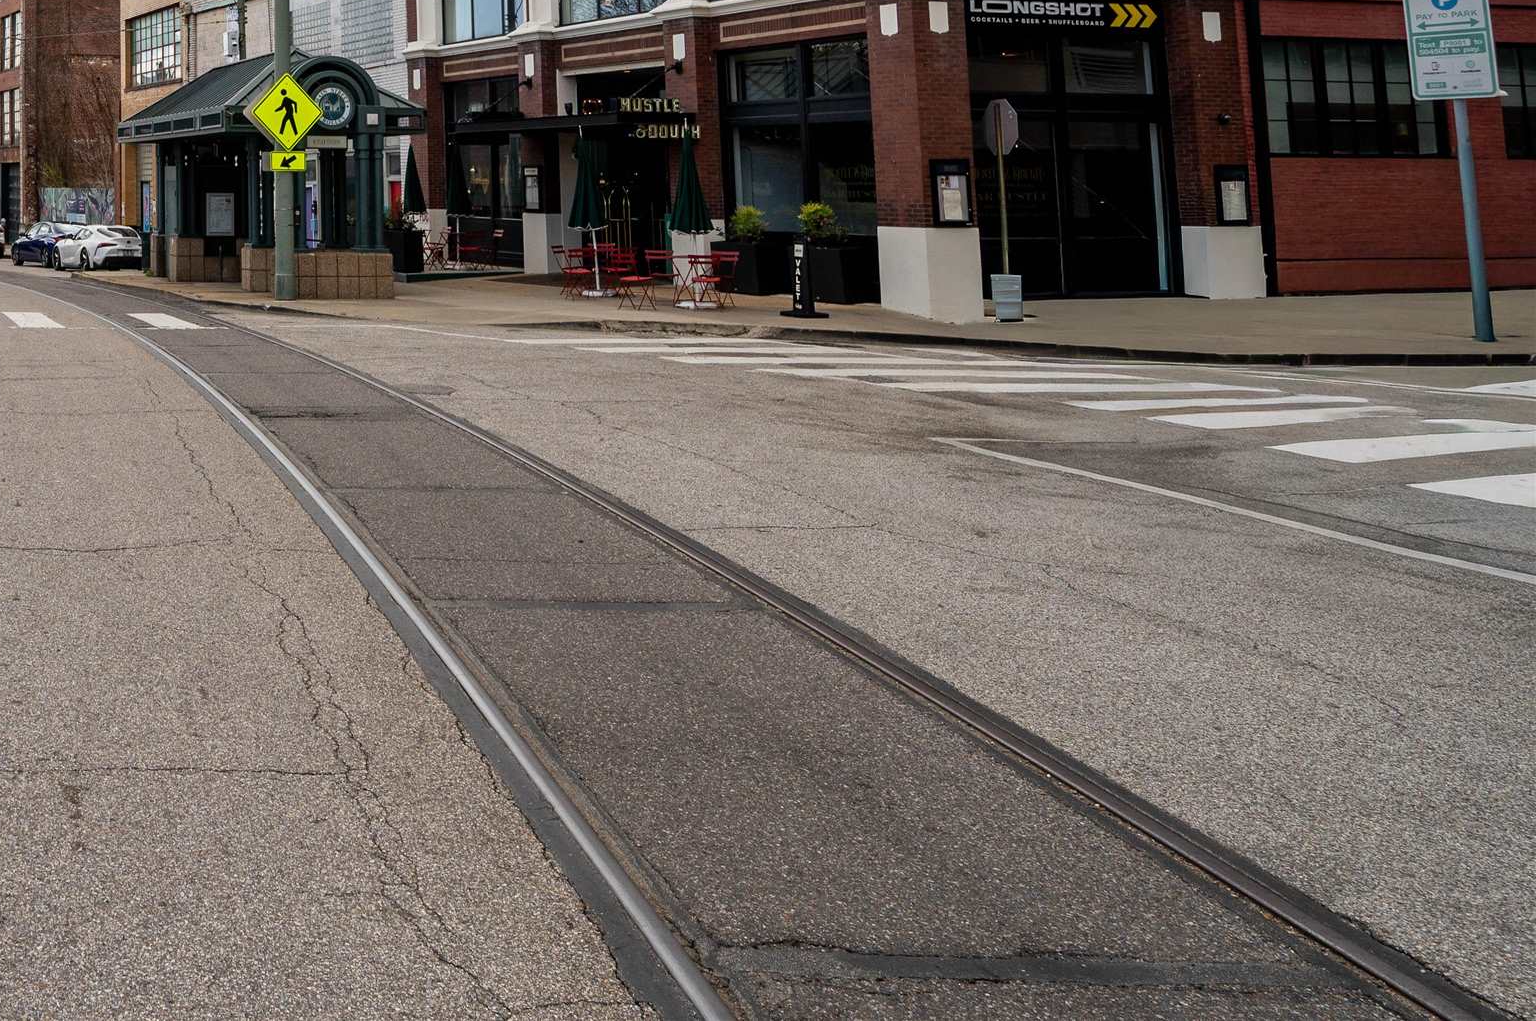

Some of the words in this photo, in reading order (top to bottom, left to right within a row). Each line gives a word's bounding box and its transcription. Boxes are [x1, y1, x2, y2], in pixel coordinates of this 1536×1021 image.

[969, 0, 1105, 16] LONGSHOT
[1451, 9, 1478, 18] PARK
[970, 16, 1013, 24] COCKTAILS
[620, 97, 681, 113] HUSTLE
